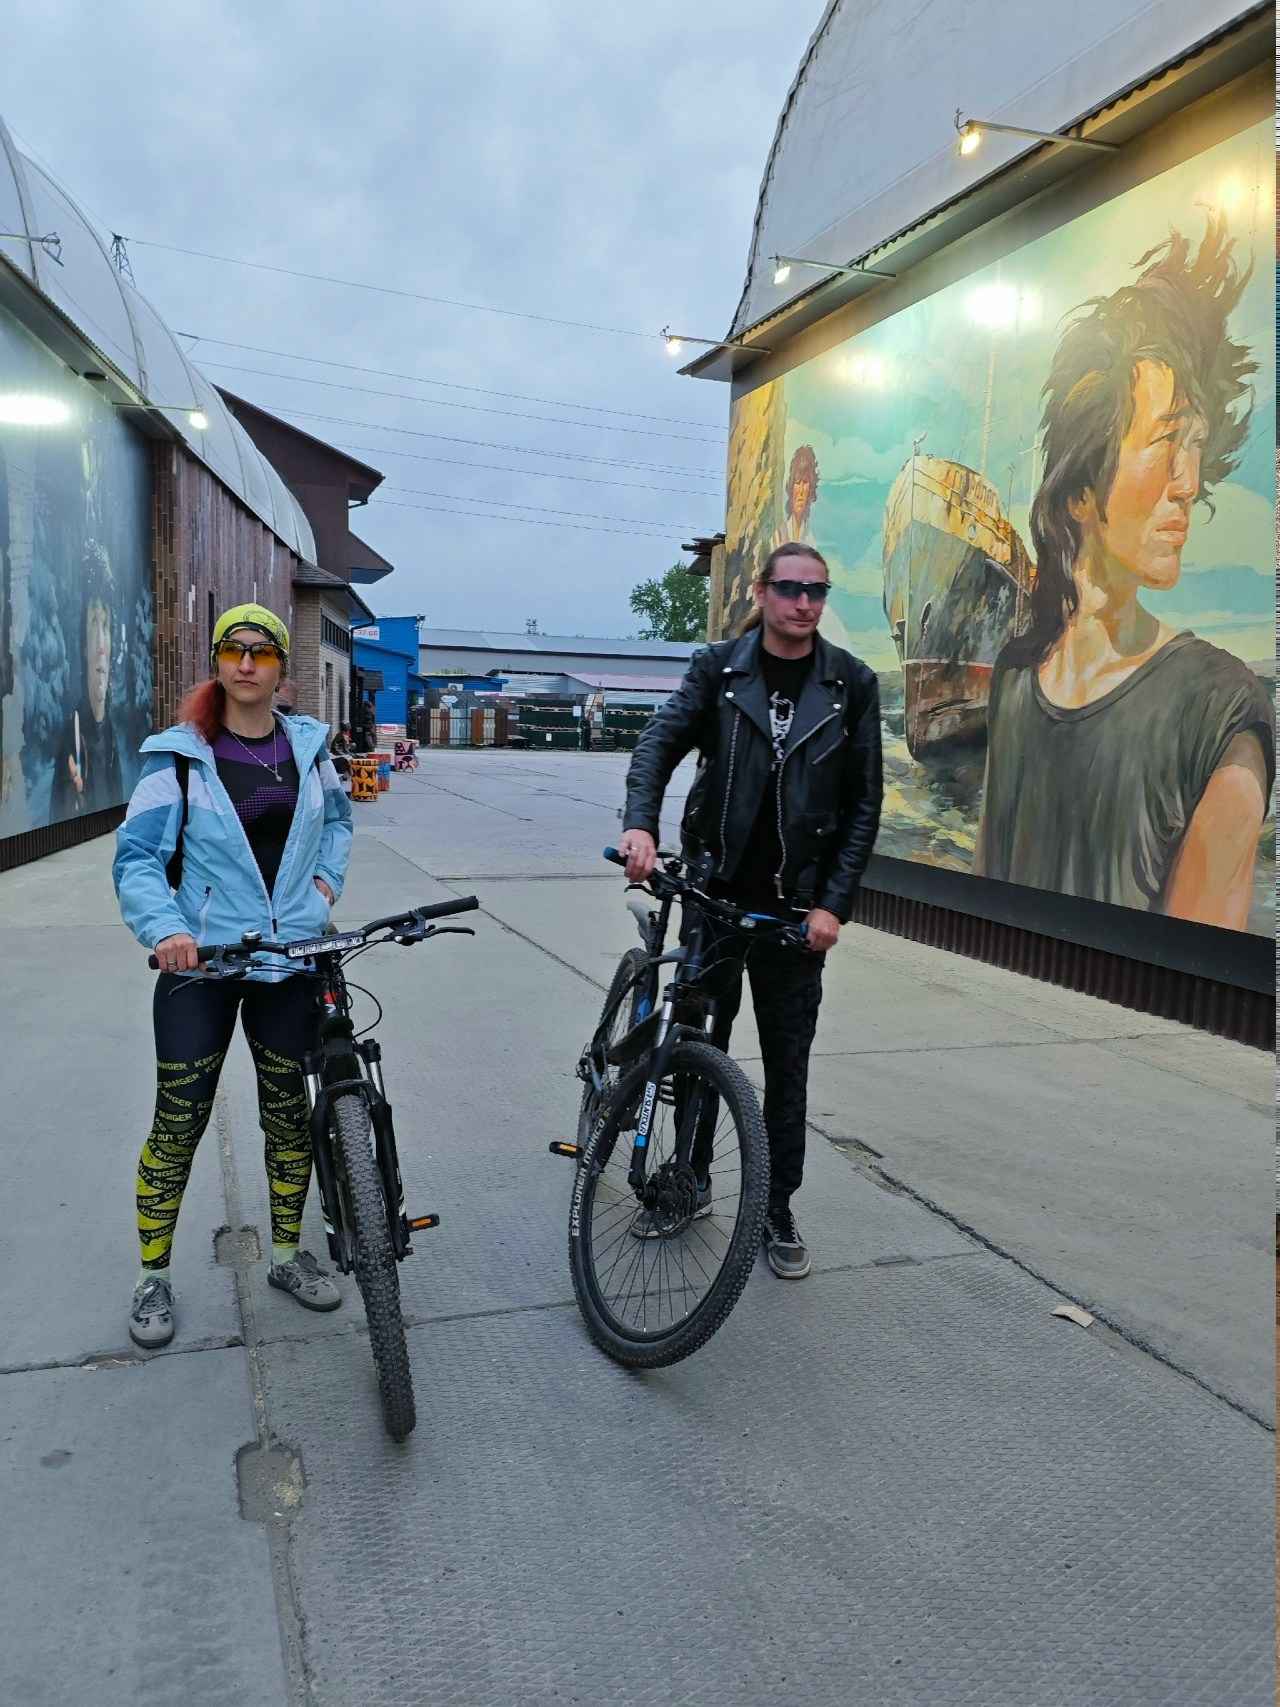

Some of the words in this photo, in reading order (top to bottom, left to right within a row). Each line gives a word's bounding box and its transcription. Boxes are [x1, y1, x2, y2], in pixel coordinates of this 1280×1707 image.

[157, 1062, 188, 1070] ANGER
[163, 1073, 201, 1088] DANGER
[157, 1133, 174, 1141] OUT
[571, 1168, 587, 1236] EXPLORER
[584, 1120, 605, 1165] MARCO
